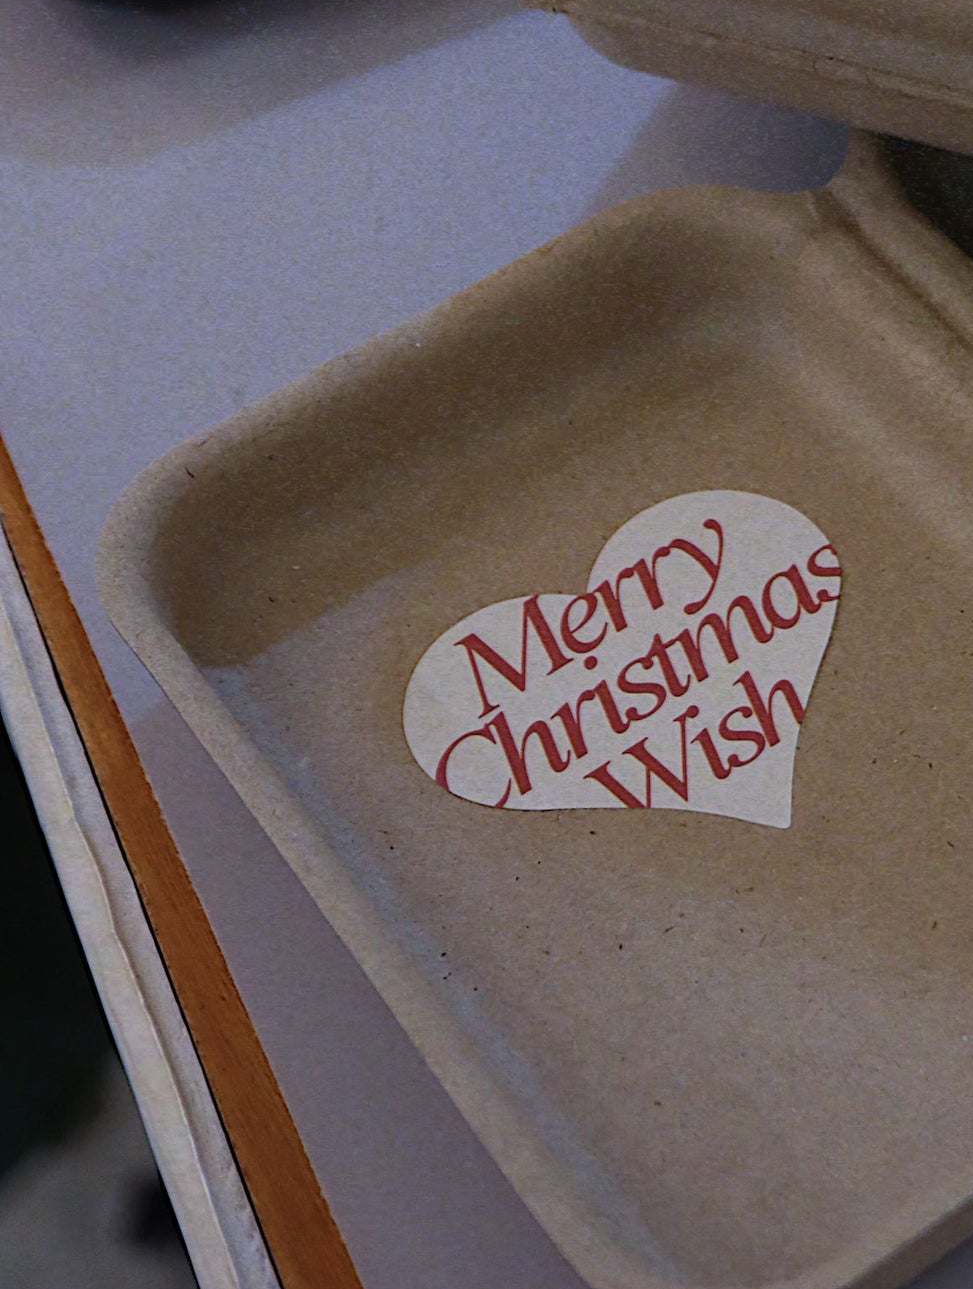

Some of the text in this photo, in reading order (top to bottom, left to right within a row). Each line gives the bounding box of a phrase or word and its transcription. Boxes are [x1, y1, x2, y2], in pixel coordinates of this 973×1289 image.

[435, 543, 843, 809] Christmas
[454, 518, 724, 718] Merry
[583, 670, 805, 809] Wish
